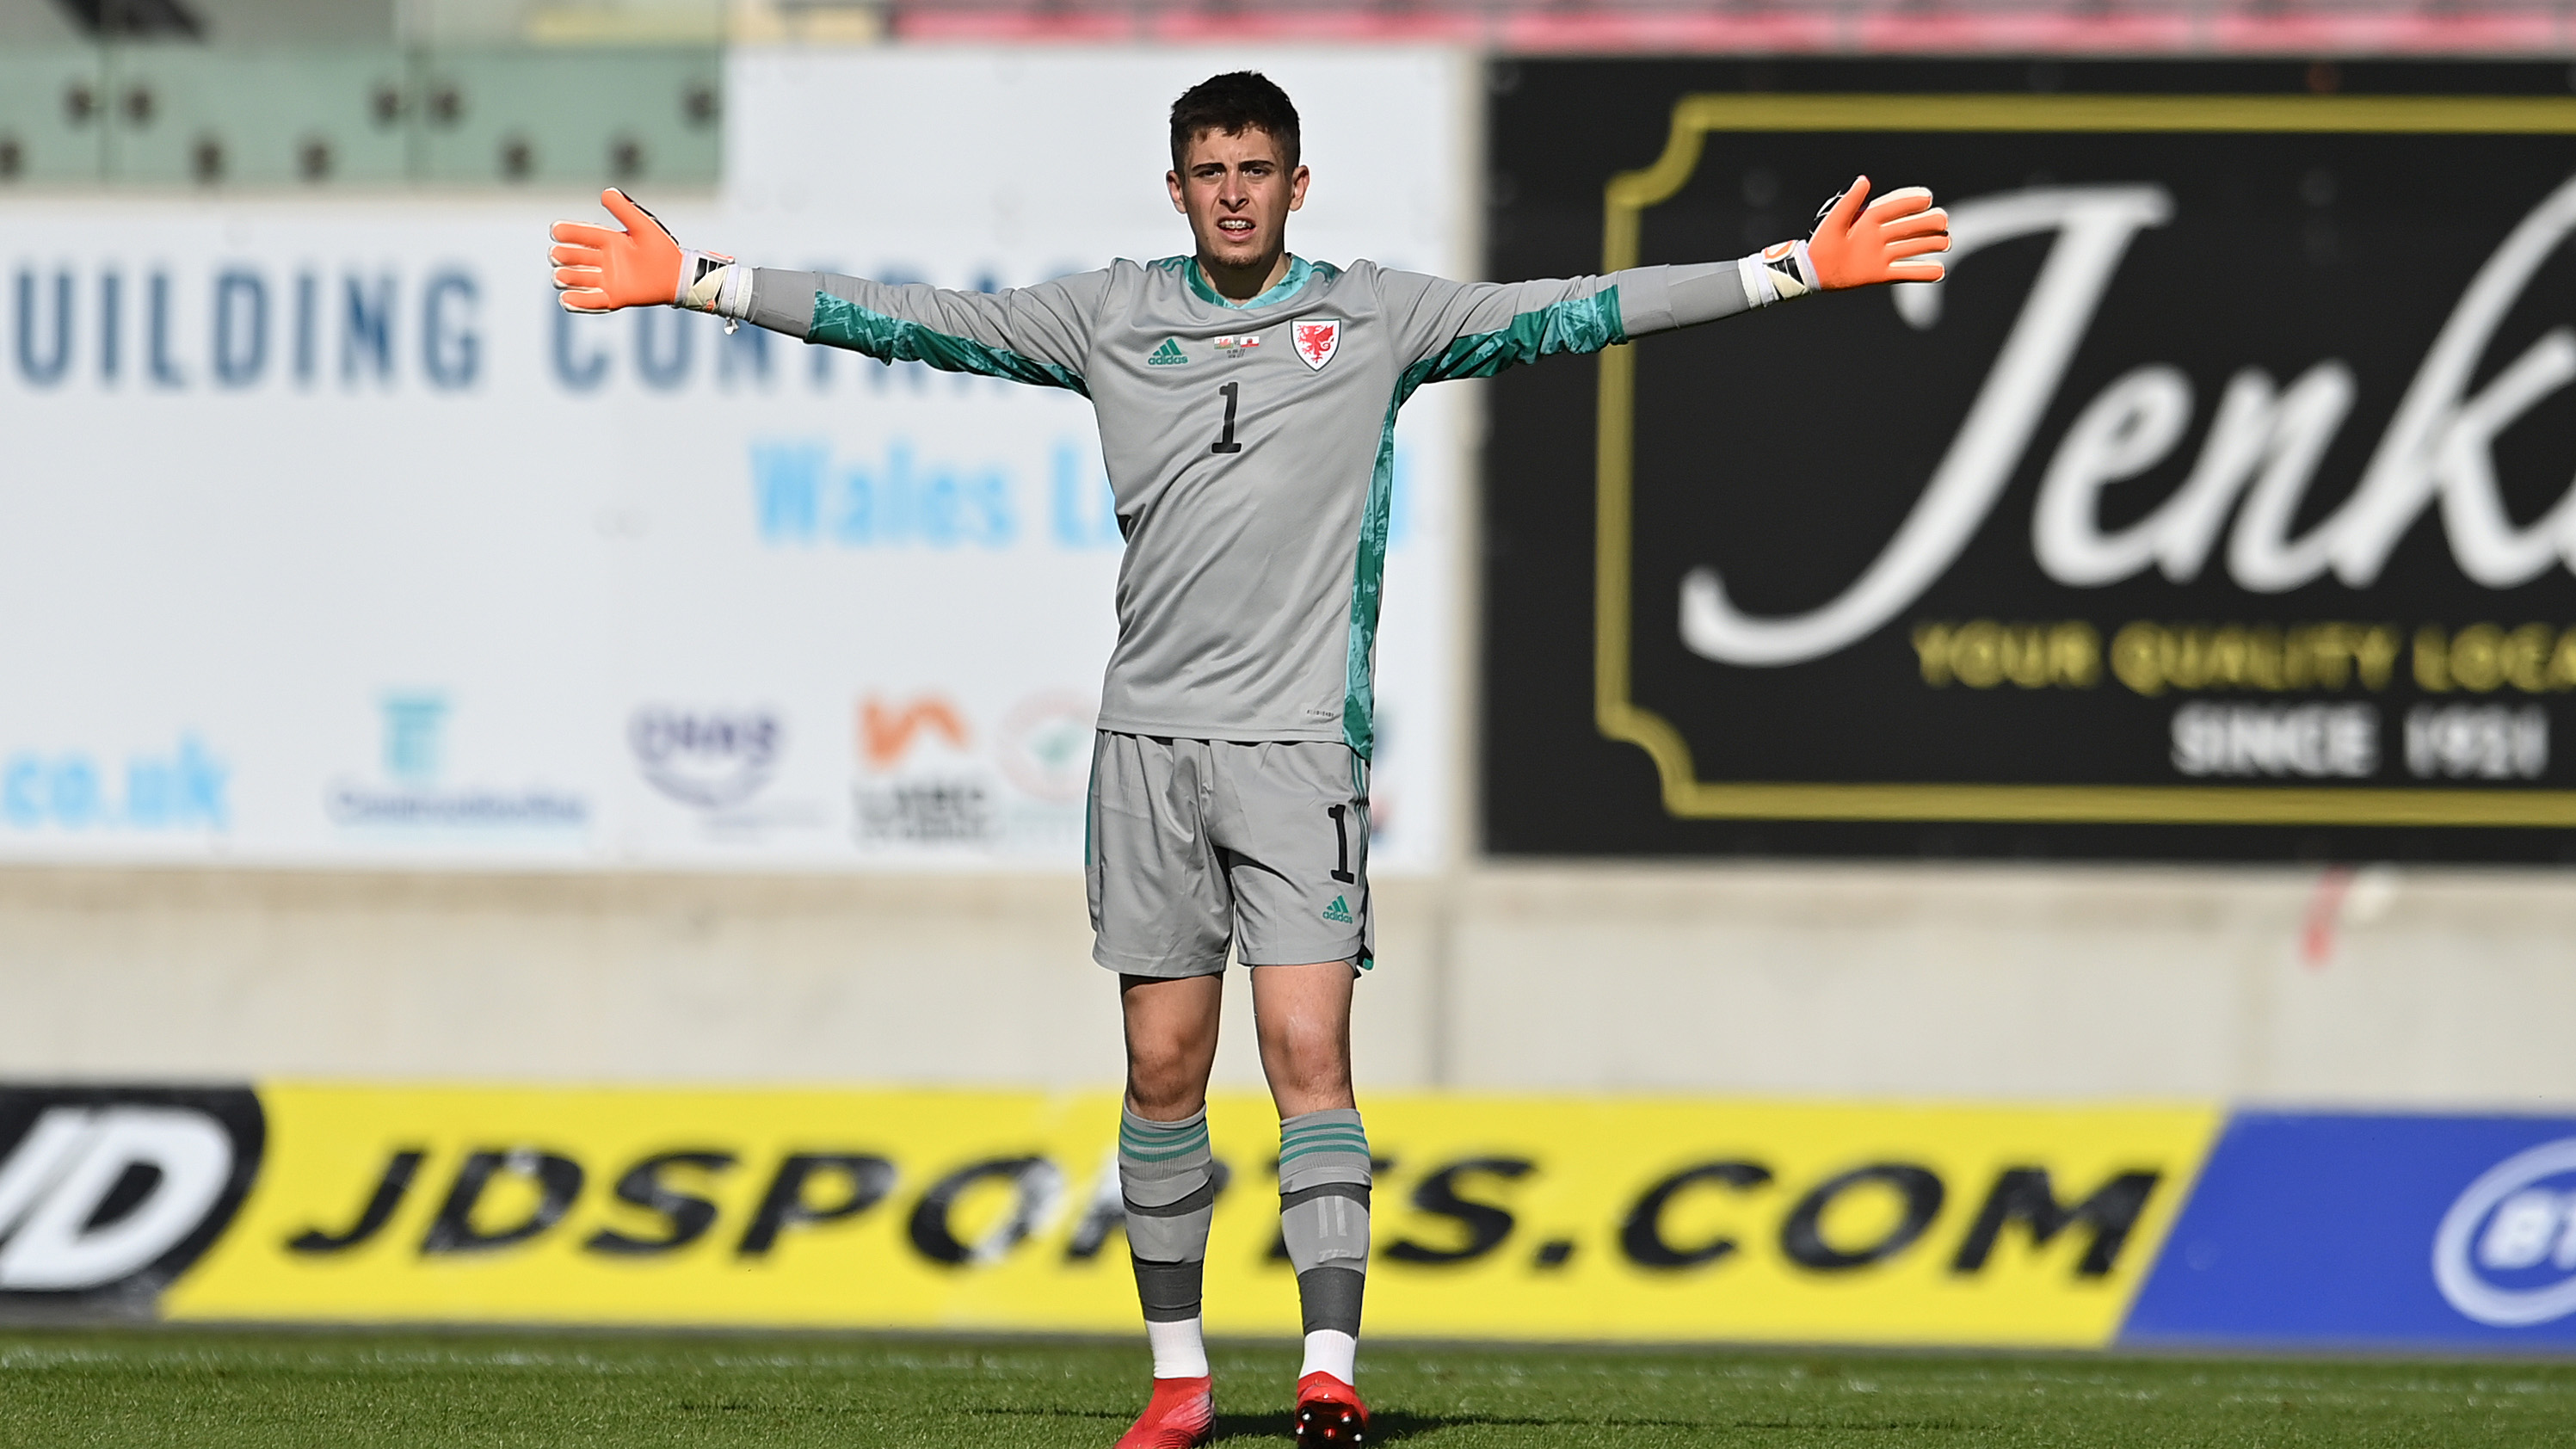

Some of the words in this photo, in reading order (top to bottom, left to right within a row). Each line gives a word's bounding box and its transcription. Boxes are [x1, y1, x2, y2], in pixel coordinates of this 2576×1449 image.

[1148, 355, 1188, 365] adidas
[1211, 381, 1242, 454] 1
[1679, 170, 2576, 667] Jenk
[749, 441, 1015, 546] Wales
[1912, 620, 2101, 688] YOUR
[2108, 620, 2404, 695] QUALITY
[2170, 700, 2383, 777] SINCE
[1327, 804, 1355, 885] 1
[1322, 909, 1353, 925] adidas
